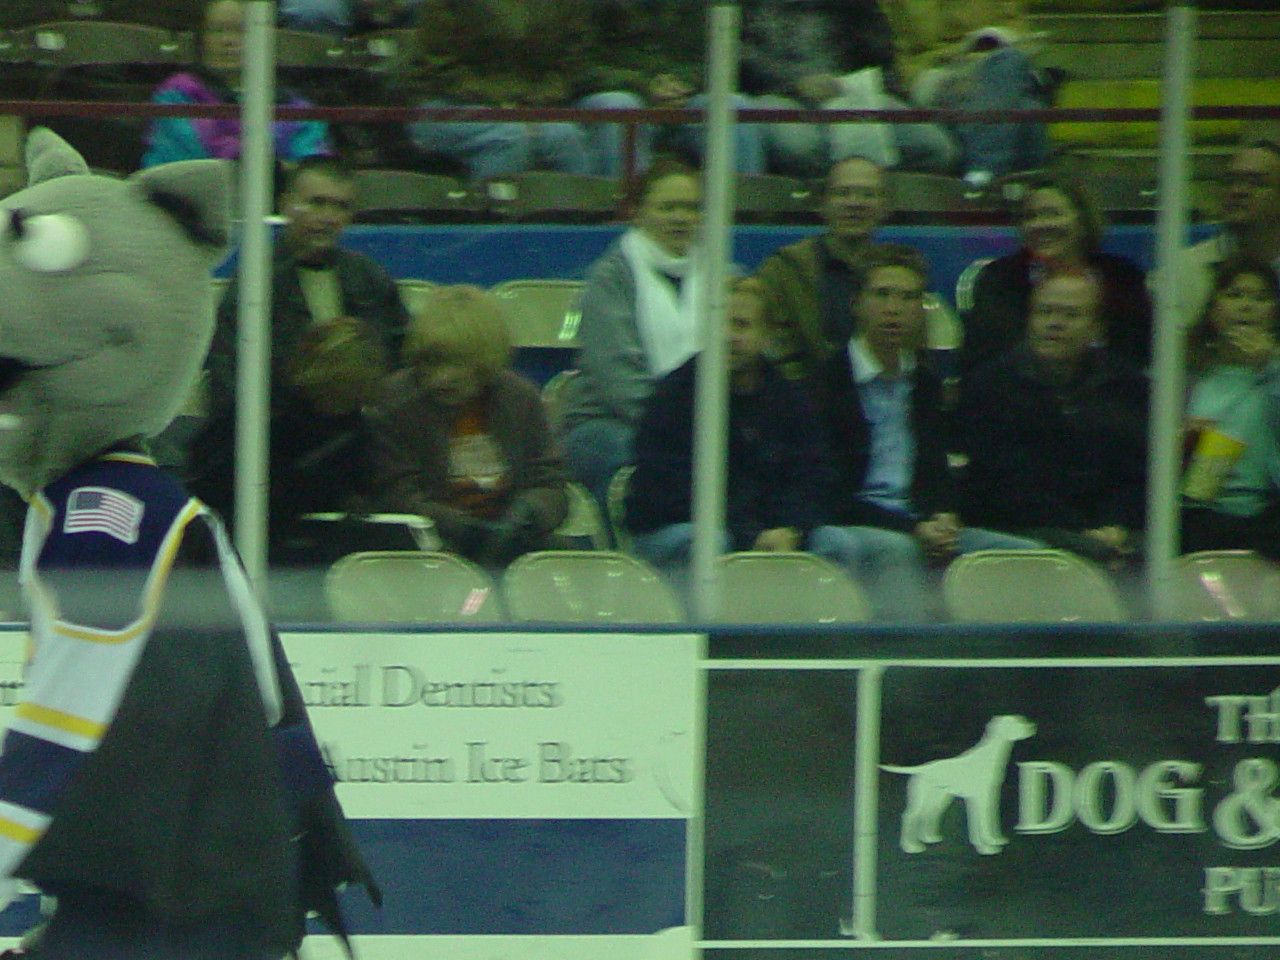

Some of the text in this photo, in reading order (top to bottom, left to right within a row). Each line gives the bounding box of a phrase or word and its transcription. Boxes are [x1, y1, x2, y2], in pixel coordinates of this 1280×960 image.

[379, 665, 564, 708] Dentists
[464, 741, 532, 784] Ice
[1014, 758, 1280, 850] DOG &
